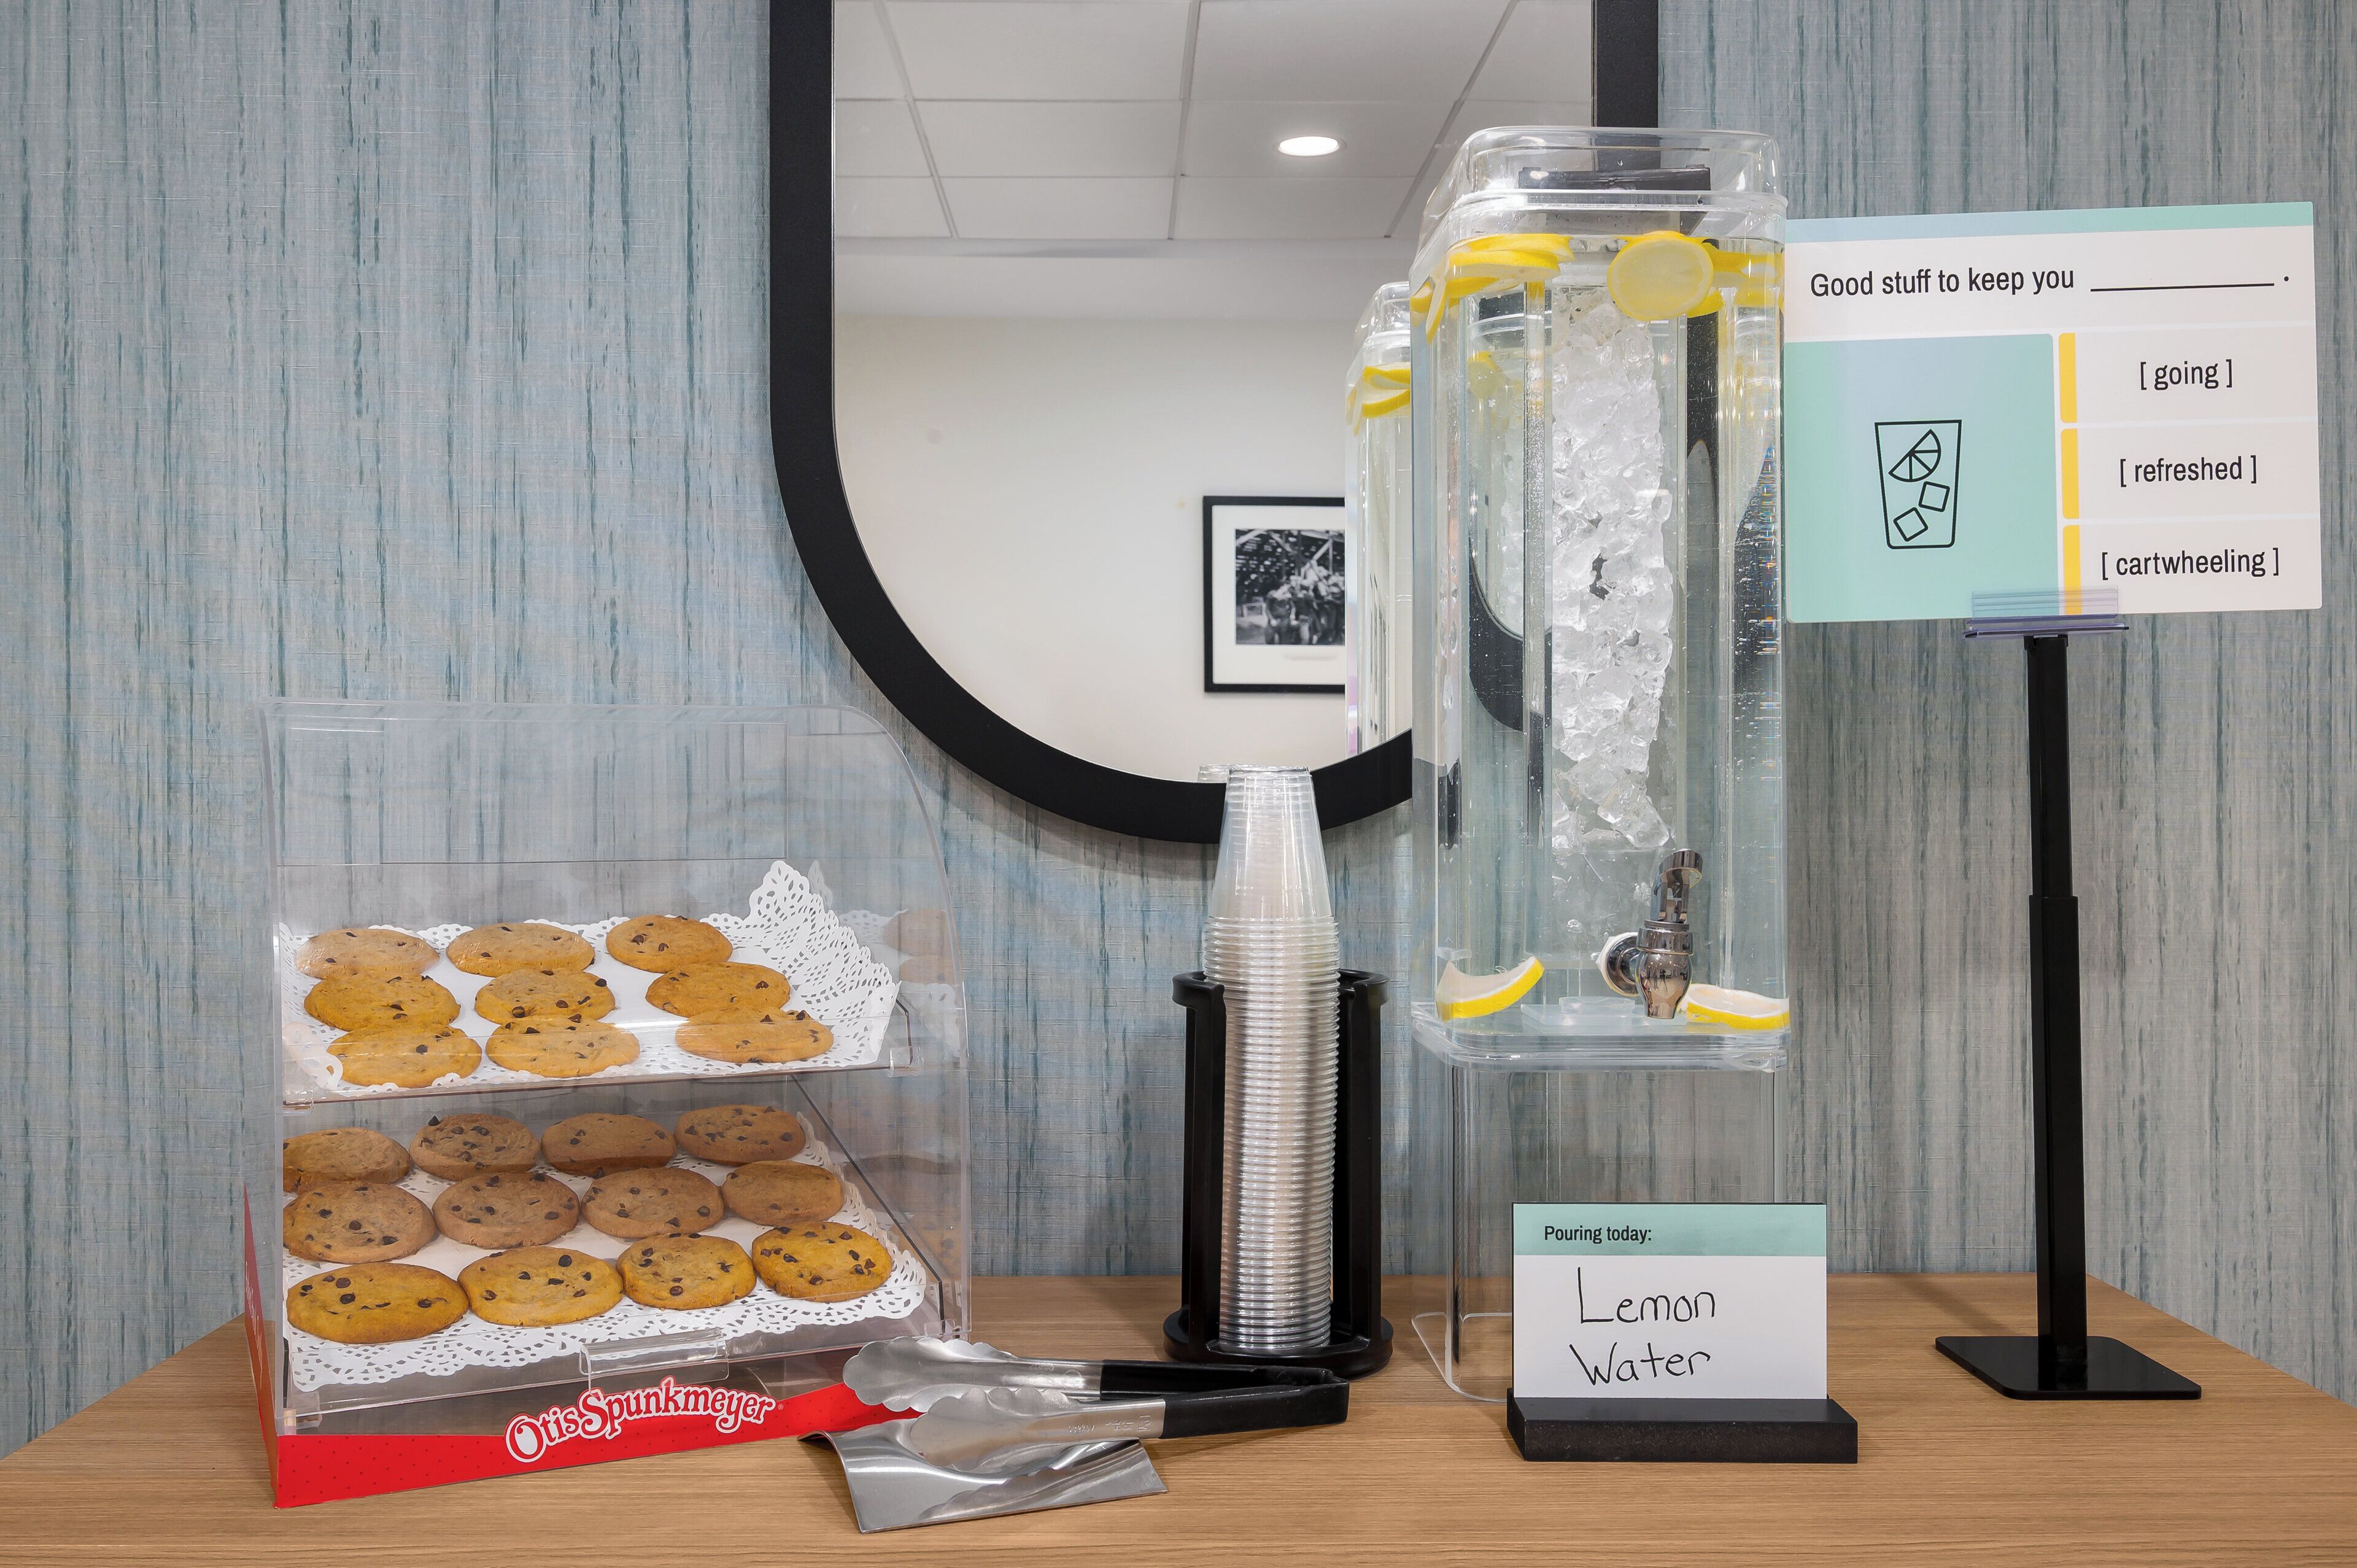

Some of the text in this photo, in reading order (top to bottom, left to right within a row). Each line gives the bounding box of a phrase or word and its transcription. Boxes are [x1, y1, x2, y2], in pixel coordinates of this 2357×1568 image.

[1811, 271, 1873, 297] Good
[1882, 268, 1931, 295] stuff
[1938, 269, 1960, 293] to
[1968, 267, 2024, 295] keep
[2032, 270, 2073, 295] you
[2154, 360, 2219, 391] going
[2135, 455, 2242, 482] refreshed
[2116, 549, 2266, 577] cartwheeling
[1544, 1225, 1652, 1245] Pouring today:
[1577, 1267, 1716, 1324] Lemon
[1569, 1342, 1711, 1386] Water
